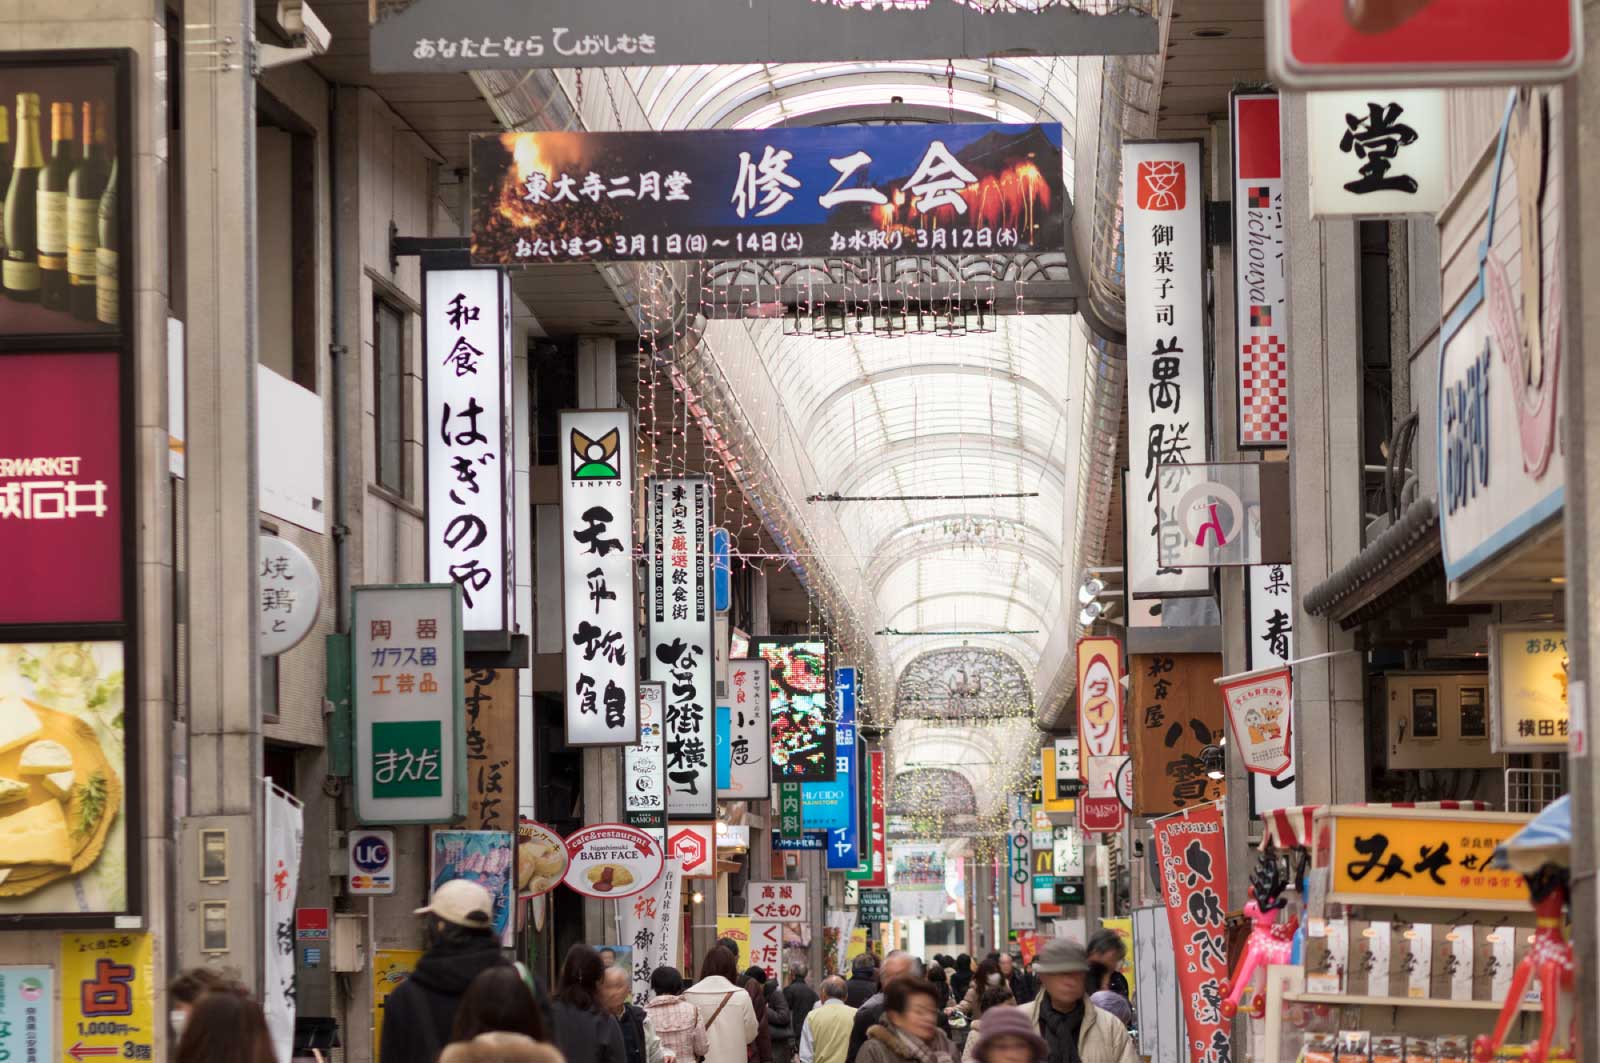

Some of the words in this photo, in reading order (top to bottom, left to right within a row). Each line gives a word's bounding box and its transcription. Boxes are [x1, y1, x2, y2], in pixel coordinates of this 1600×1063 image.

[413, 37, 544, 59] あなたとなら
[552, 27, 656, 56] ひがしむき
[1340, 102, 1419, 195] 堂
[522, 170, 693, 203] 東大寺二月堂
[731, 140, 979, 219] 修二会
[515, 236, 603, 257] おたいまつ
[829, 228, 903, 252] お水取り
[1245, 210, 1272, 303] ichouya
[1151, 224, 1174, 326] 御菓子司
[443, 293, 484, 377] 和食
[441, 397, 496, 609] はぎのや
[655, 585, 664, 617] COURT
[696, 585, 705, 617] COURT
[371, 647, 437, 667] ガラス器
[372, 673, 438, 694] 工芸品
[1089, 679, 1110, 753] ダイソー
[375, 748, 440, 784] まえだ
[1086, 805, 1118, 814] DAISO
[357, 845, 386, 863] UC
[571, 831, 648, 848] cafe&restaurant
[580, 851, 608, 861] BABY
[611, 850, 638, 860] FACE
[1347, 834, 1452, 885] みそ
[762, 886, 792, 898] 高級
[753, 903, 800, 917] くだもの
[81, 958, 135, 1017] 占
